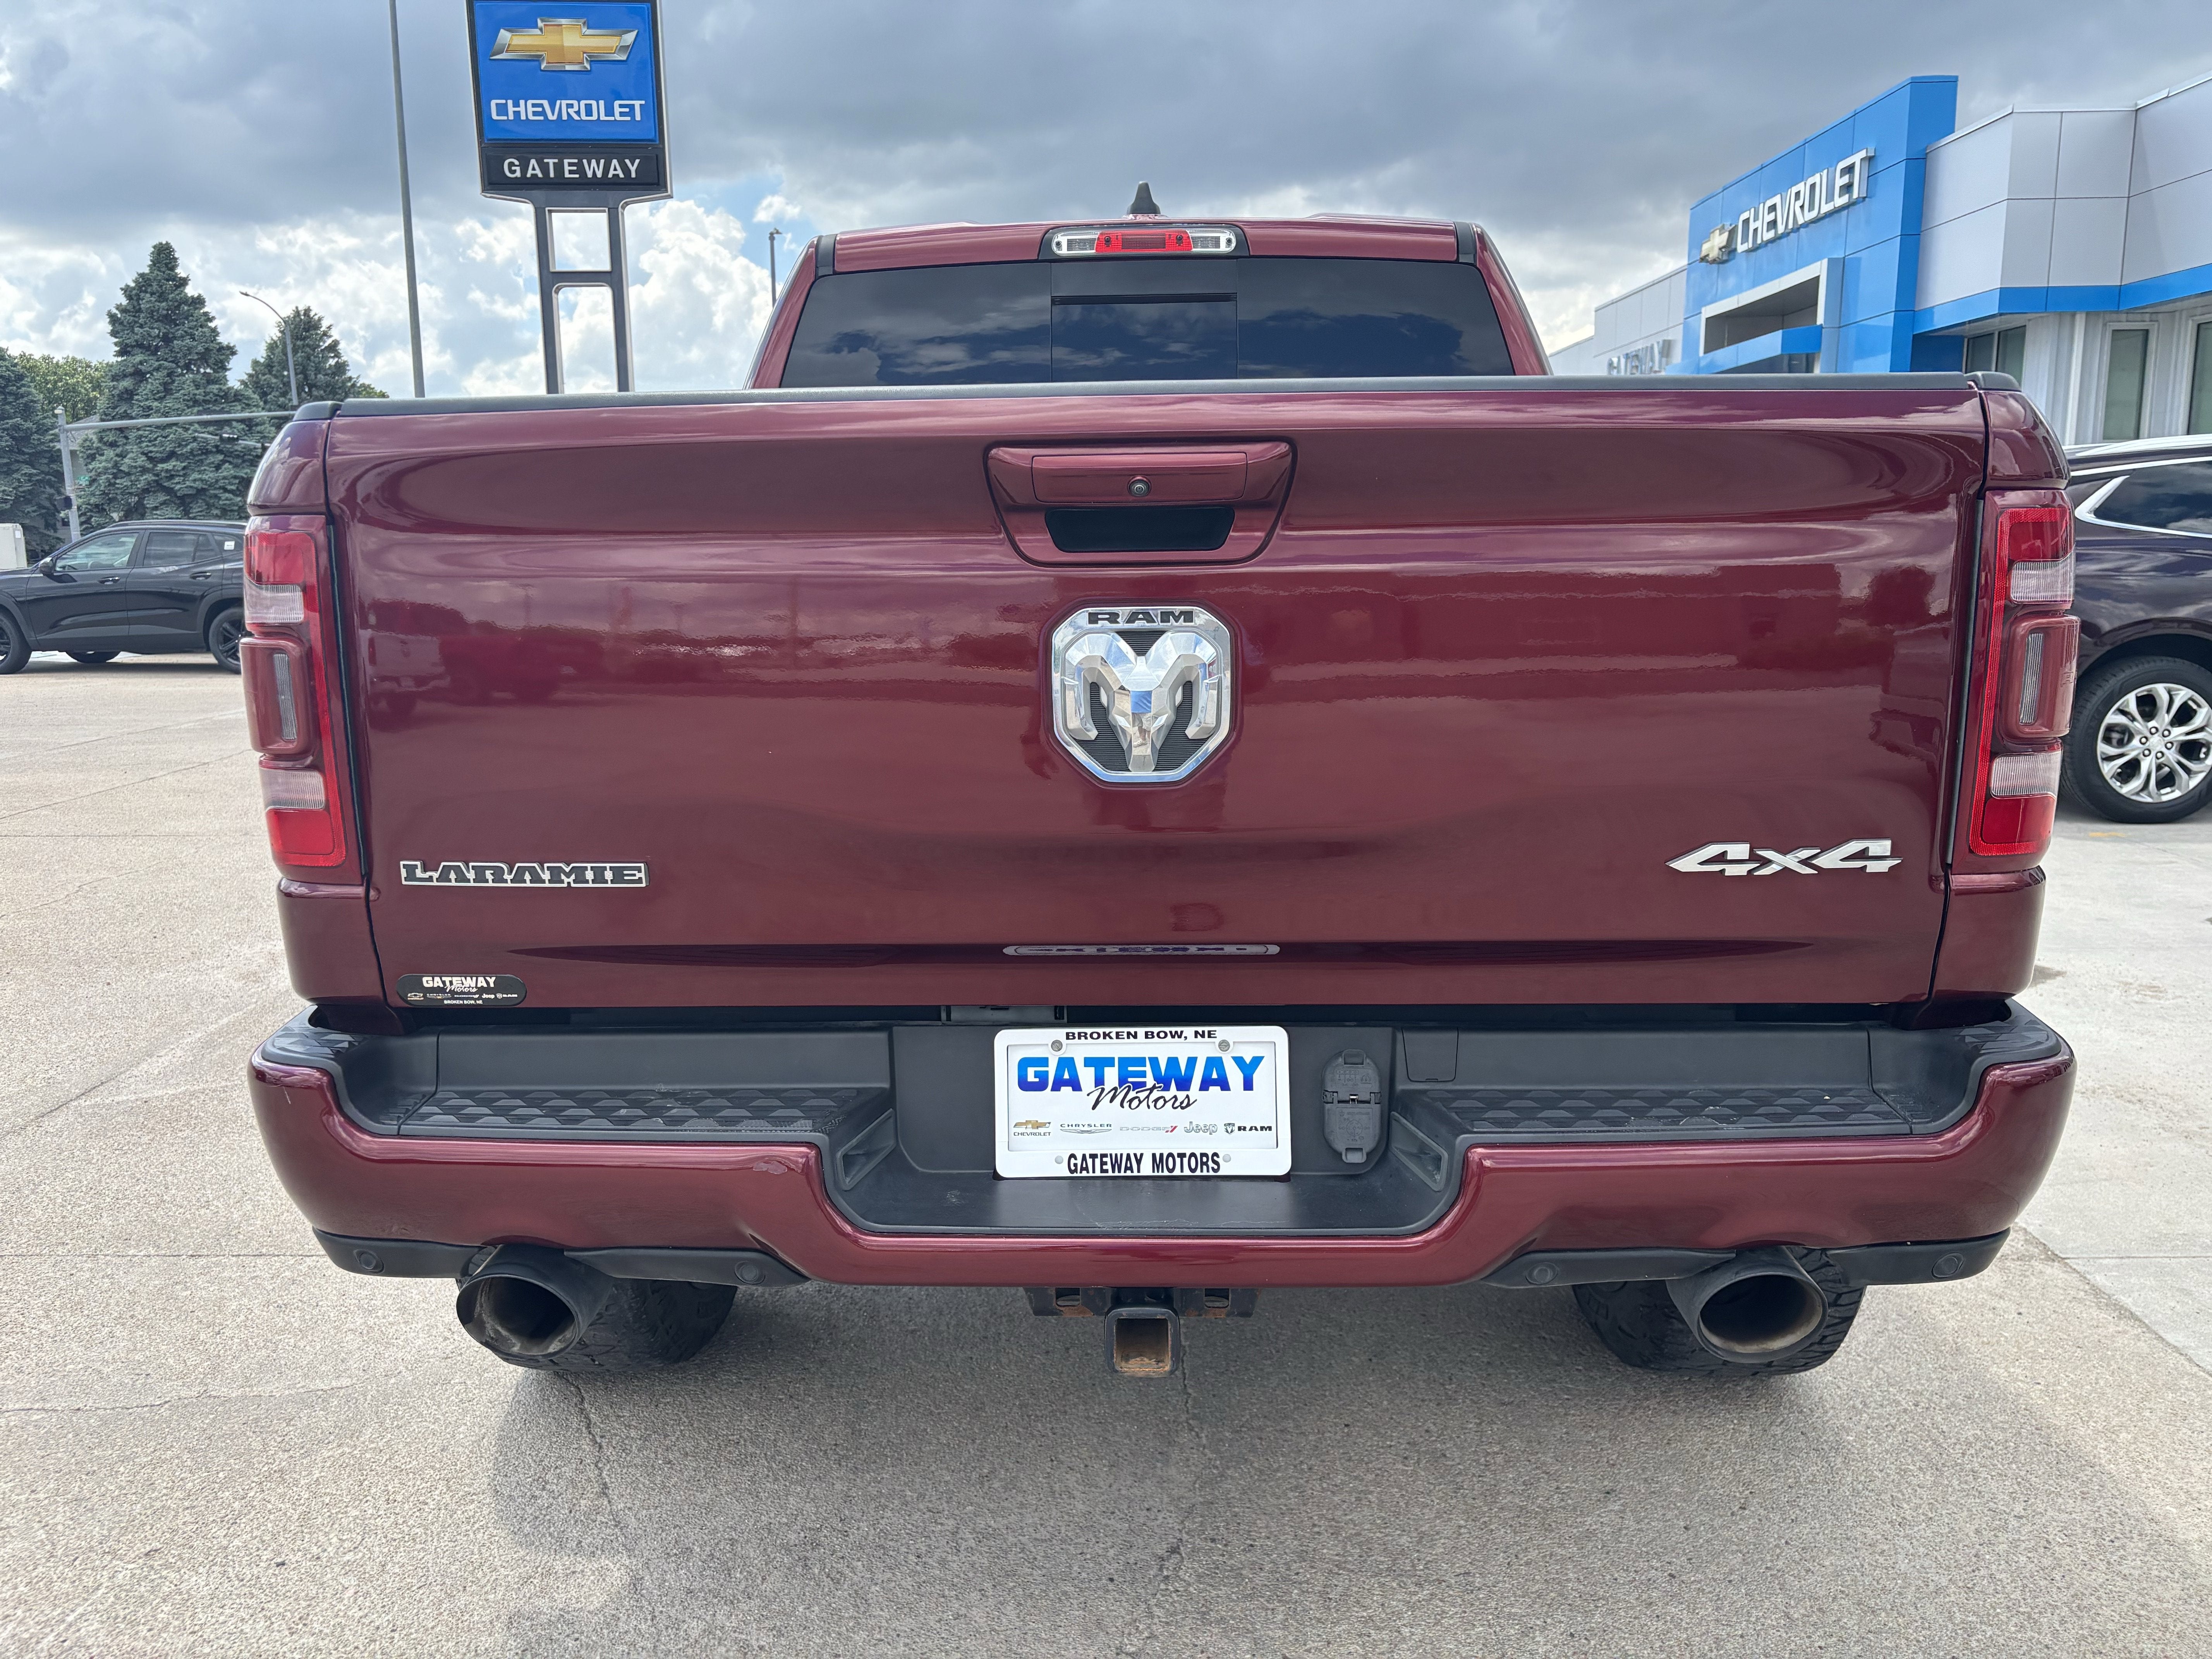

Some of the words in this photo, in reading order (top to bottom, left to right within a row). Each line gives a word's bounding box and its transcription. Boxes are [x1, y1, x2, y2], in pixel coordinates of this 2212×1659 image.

[490, 99, 645, 121] CHEVROLET
[503, 158, 640, 178] GATEWAY
[1737, 148, 1874, 253] CHEVROLET
[1088, 610, 1194, 625] RAM
[400, 860, 649, 887] LARAMIE
[422, 977, 496, 988] GATEWAY
[445, 984, 478, 993] Motors
[1066, 1030, 1138, 1040] BROKEN
[1145, 1030, 1188, 1041] BOW,
[1194, 1030, 1217, 1039] NE
[1017, 1056, 1264, 1092] GATEWAY
[1087, 1083, 1197, 1110] Motors
[1184, 1121, 1218, 1135] Jeep
[1067, 1152, 1144, 1174] GATEWAY
[1152, 1152, 1220, 1173] MOTORS
